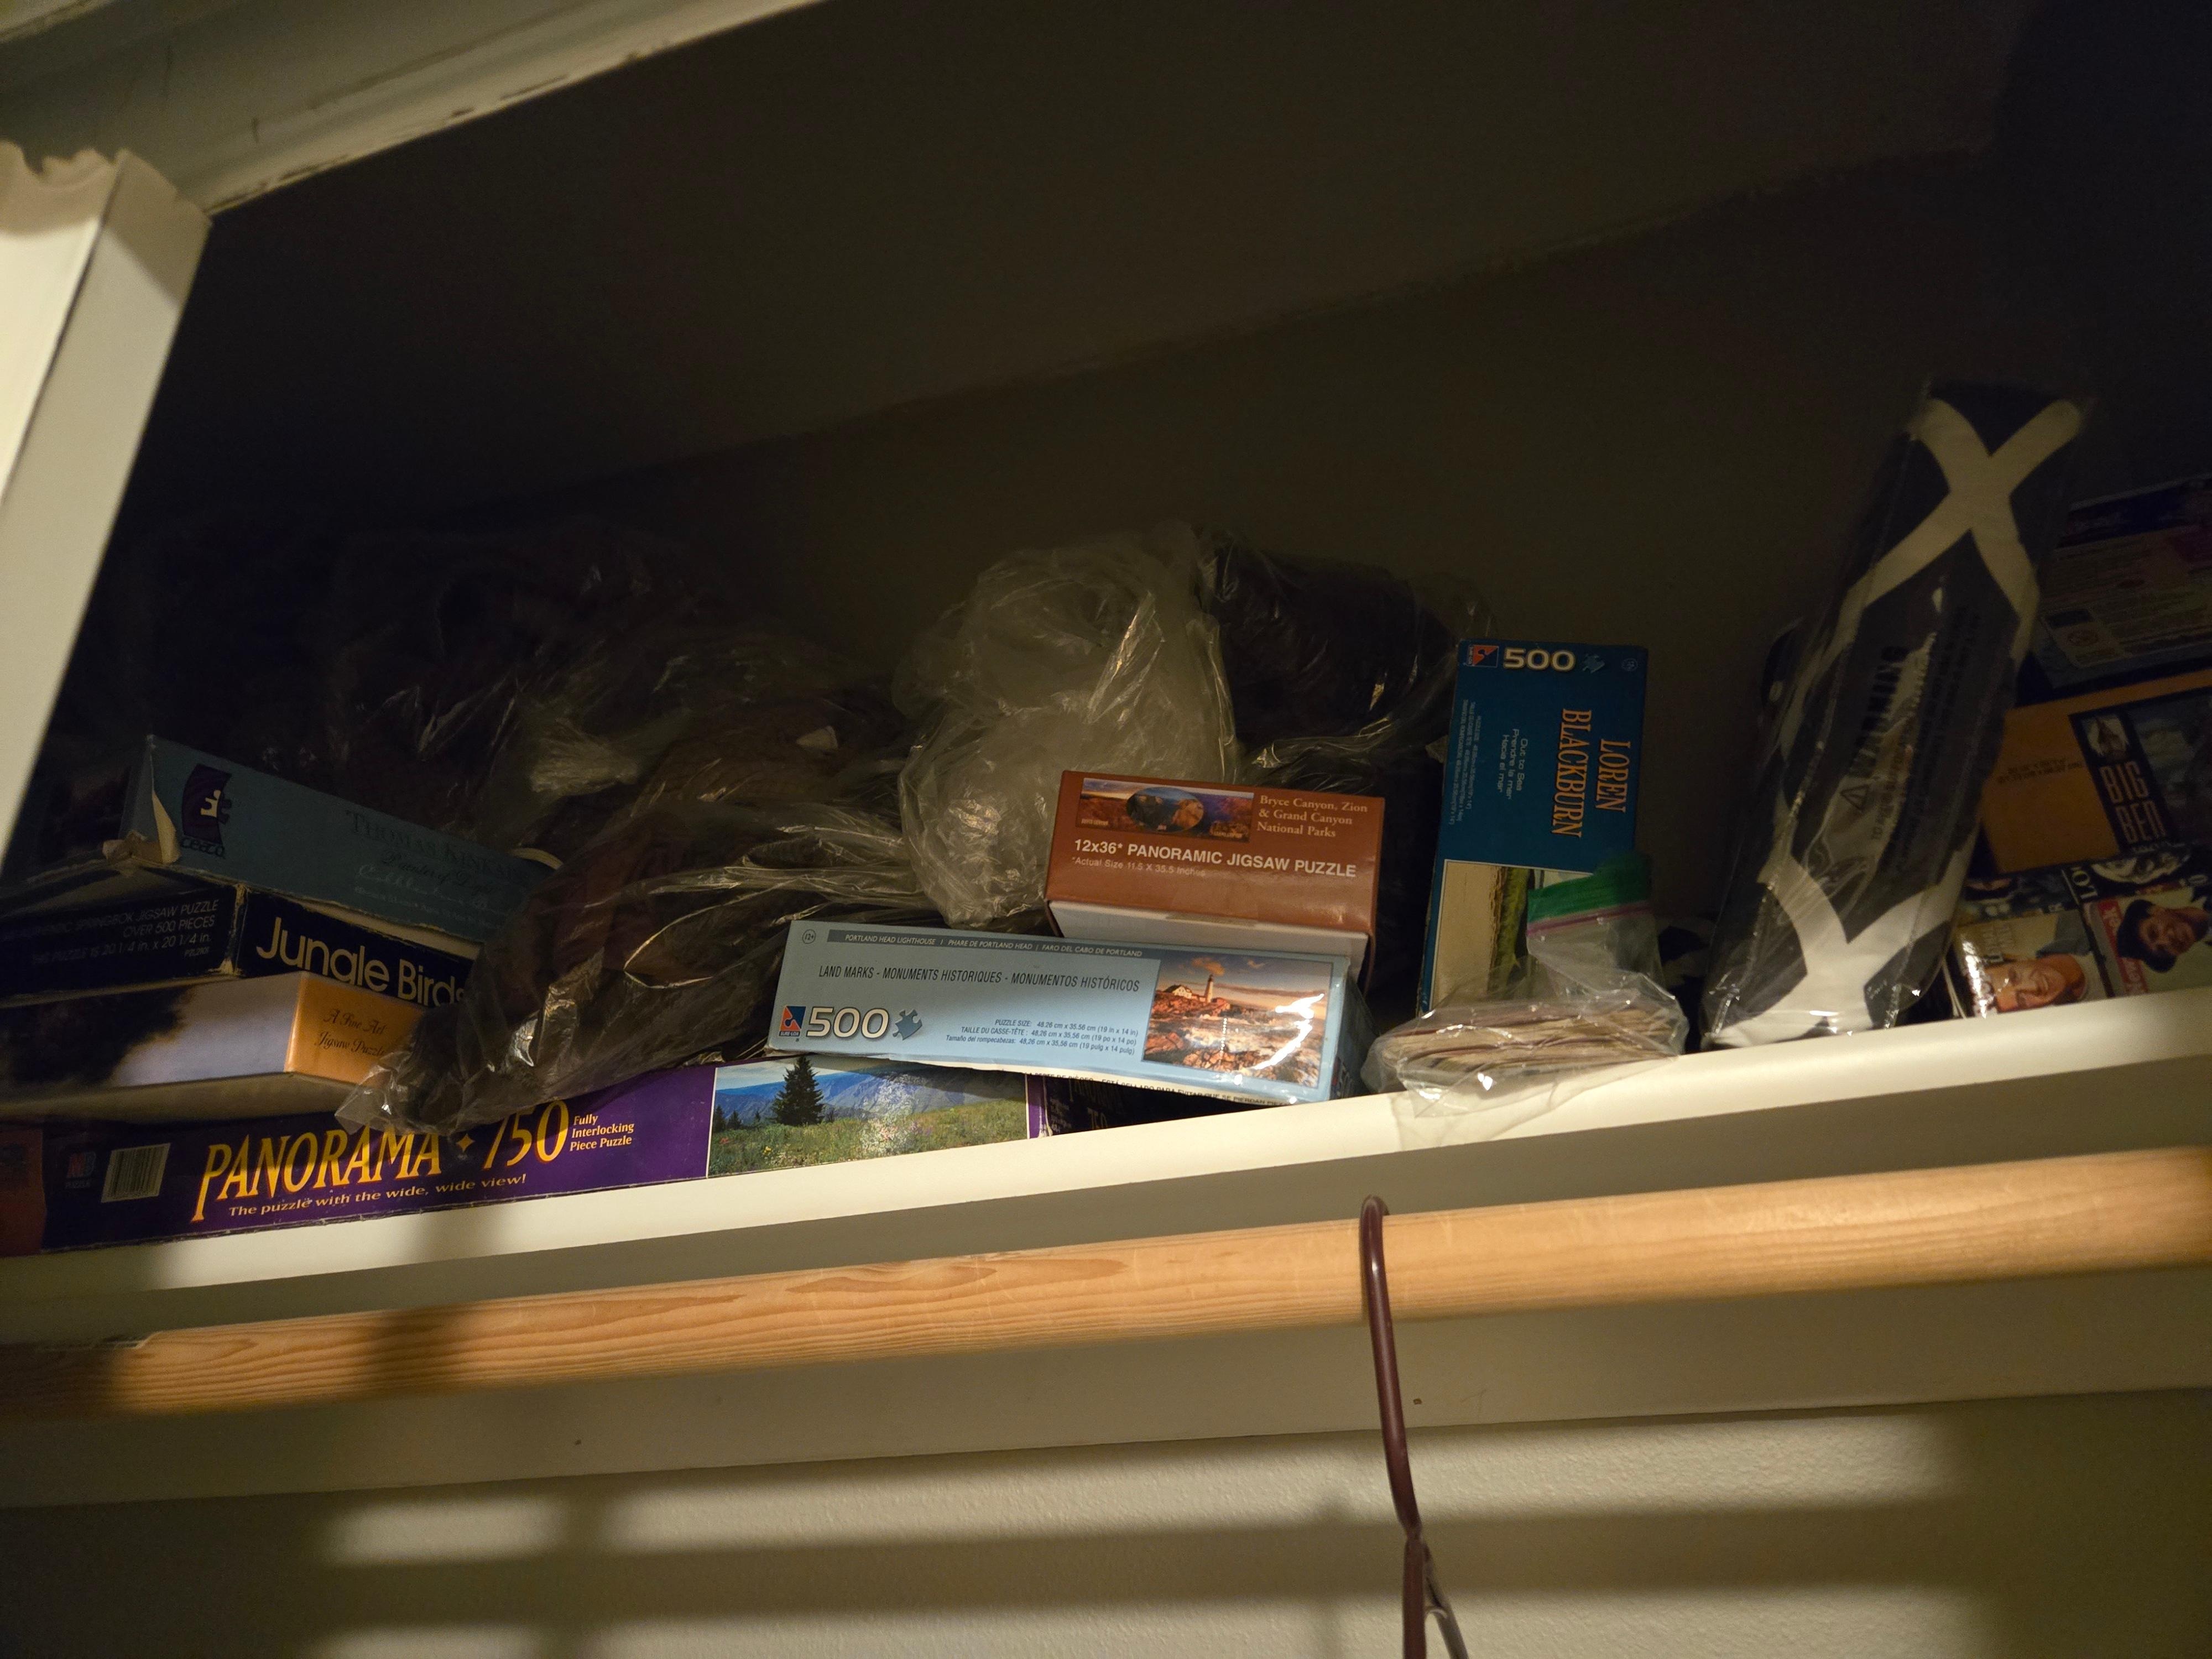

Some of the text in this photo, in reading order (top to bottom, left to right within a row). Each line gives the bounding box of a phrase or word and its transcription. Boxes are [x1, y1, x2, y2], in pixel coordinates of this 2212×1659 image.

[1503, 646, 1576, 672] 500
[1509, 728, 1520, 766] Prendre
[1516, 738, 1528, 791] Out to Sea
[1551, 707, 1592, 838] BLACKBURN
[1595, 738, 1631, 813] LOREN
[2099, 761, 2150, 805] BIG
[1259, 807, 1353, 826] & Grand Canyon
[1260, 795, 1368, 812] Bryce Canyon, Zion
[1257, 821, 1336, 837] National Parks
[2115, 800, 2167, 844] BEN
[1105, 859, 1123, 869] Size
[1128, 843, 1223, 864] PANORAMIC
[1227, 853, 1290, 871] JIGSAW
[1295, 859, 1357, 878] PUZZLE
[135, 906, 179, 922] JIGSAW
[181, 899, 220, 914] PUZZLE
[123, 915, 216, 938] OVER 500 PIECES
[163, 936, 177, 949] 20
[256, 916, 390, 993] Jungle
[845, 934, 878, 942] PORTLAND
[897, 937, 936, 945] LIGHTHOUSE
[979, 941, 1014, 950] PORTLAND
[1106, 948, 1142, 957] PORTLAND
[819, 966, 841, 977] LAND
[844, 967, 874, 978] MARKS
[883, 968, 938, 981] MONUMENTS
[941, 970, 1001, 983] HISTORIQUES
[1011, 972, 1078, 987] MONUMENTOS
[1081, 973, 1140, 992] HISTÓRICOS
[323, 1008, 387, 1035] A Fine Art
[806, 1006, 890, 1040] 500
[314, 1031, 350, 1050] Jigsaw
[1091, 1044, 1104, 1052] pulg
[571, 1122, 635, 1139] Interlocking
[573, 1113, 598, 1126] Fully
[570, 1135, 632, 1152] Piece Puzzle
[191, 1124, 442, 1222] PANORAMA
[229, 1173, 526, 1217] The puzzle with the wide, wide view!
